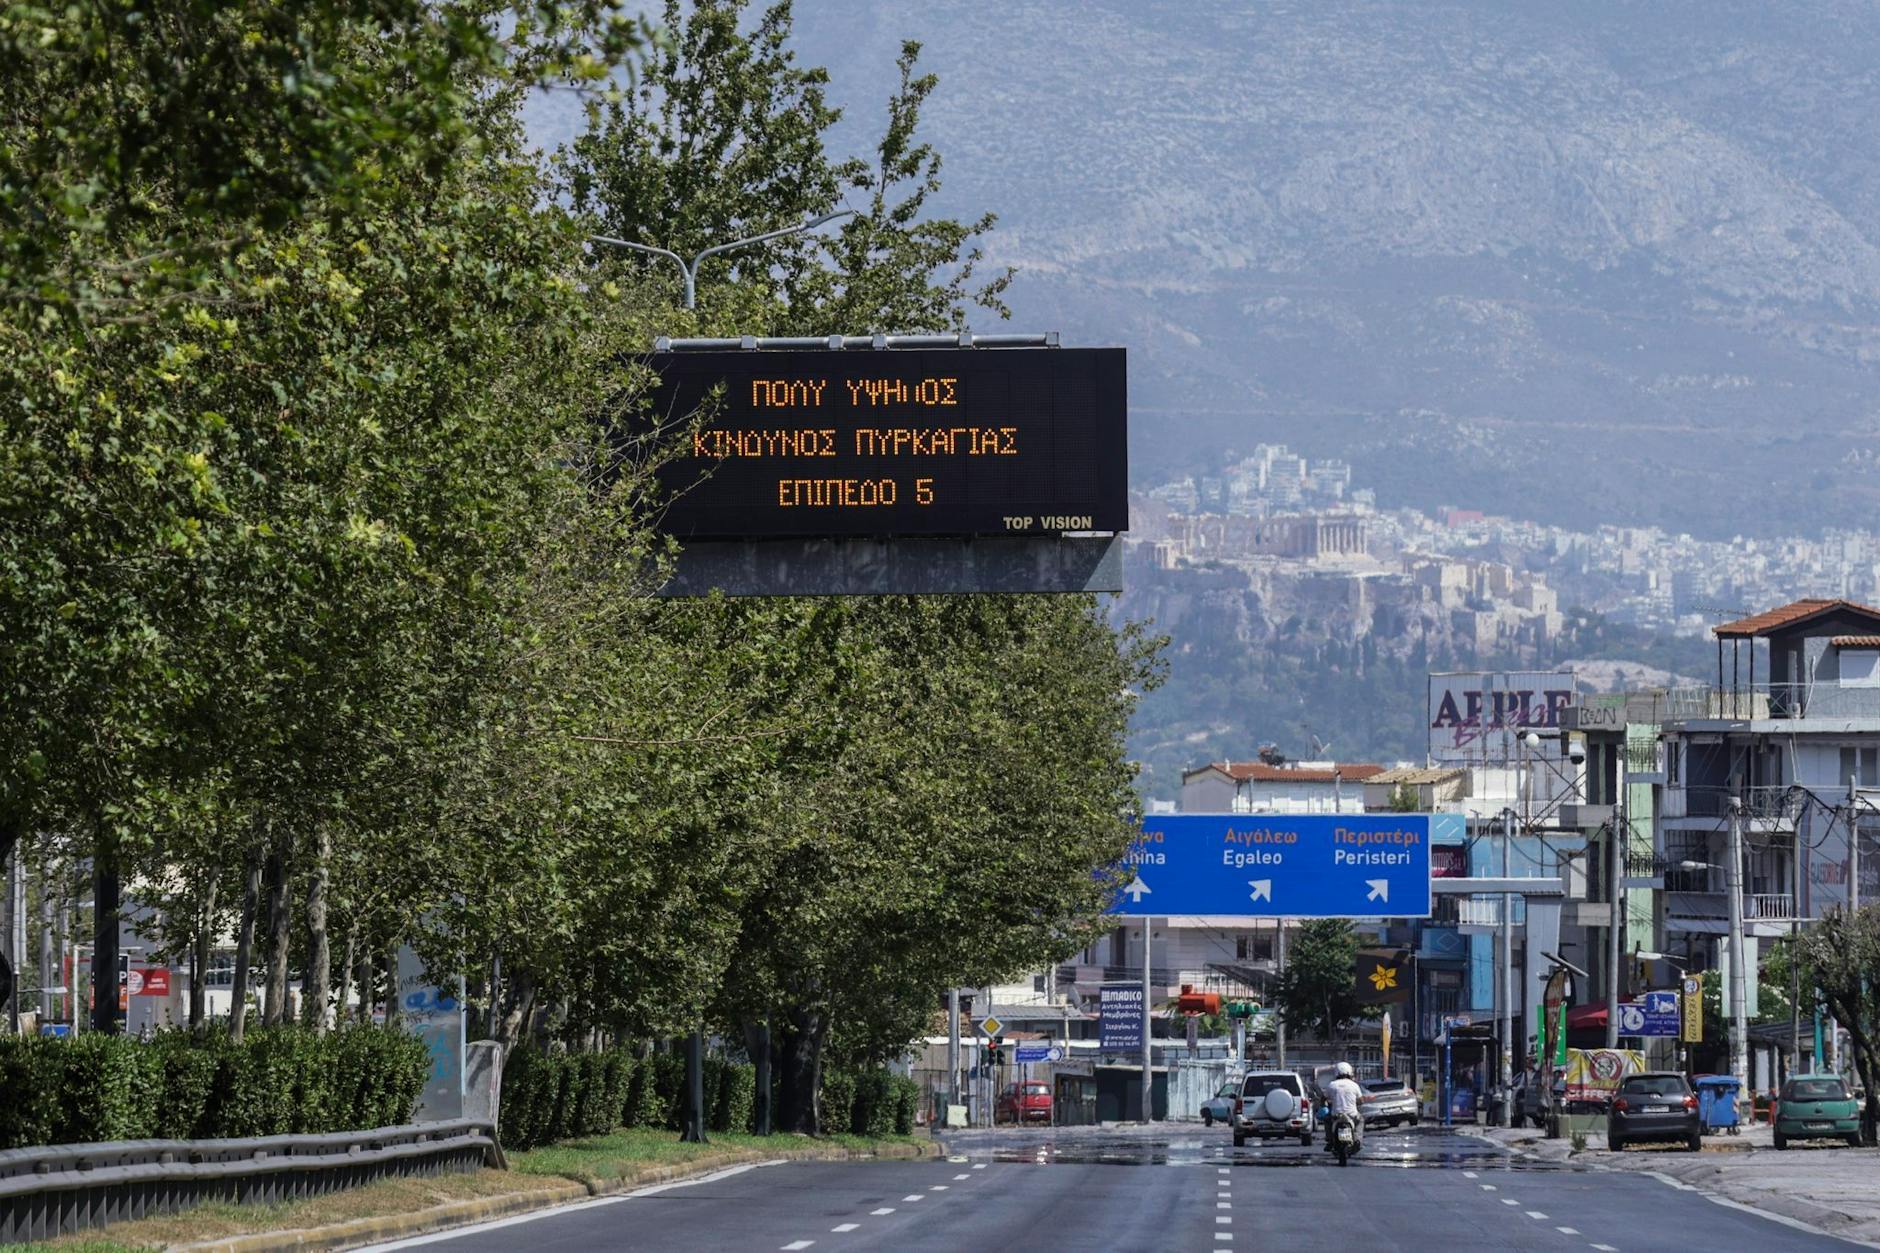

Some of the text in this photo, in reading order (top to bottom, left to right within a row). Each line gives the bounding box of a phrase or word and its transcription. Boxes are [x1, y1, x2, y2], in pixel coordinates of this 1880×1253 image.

[752, 379, 826, 407] ΠΟΛΥ
[693, 427, 1018, 457] ΚΙΝΔΥΝΟΣ ΠΥΡΚΑΓΙΑΣ
[779, 478, 934, 506] ΕΠΙΠΕΔΟ 5
[1003, 515, 1093, 530] TOP VISION
[1223, 828, 1298, 848] Αιγάλεω
[1334, 827, 1420, 848] Περιστέρι
[1223, 849, 1282, 869] Egaleo
[1335, 849, 1411, 866] Peristeri
[1110, 991, 1142, 1002] MADICO
